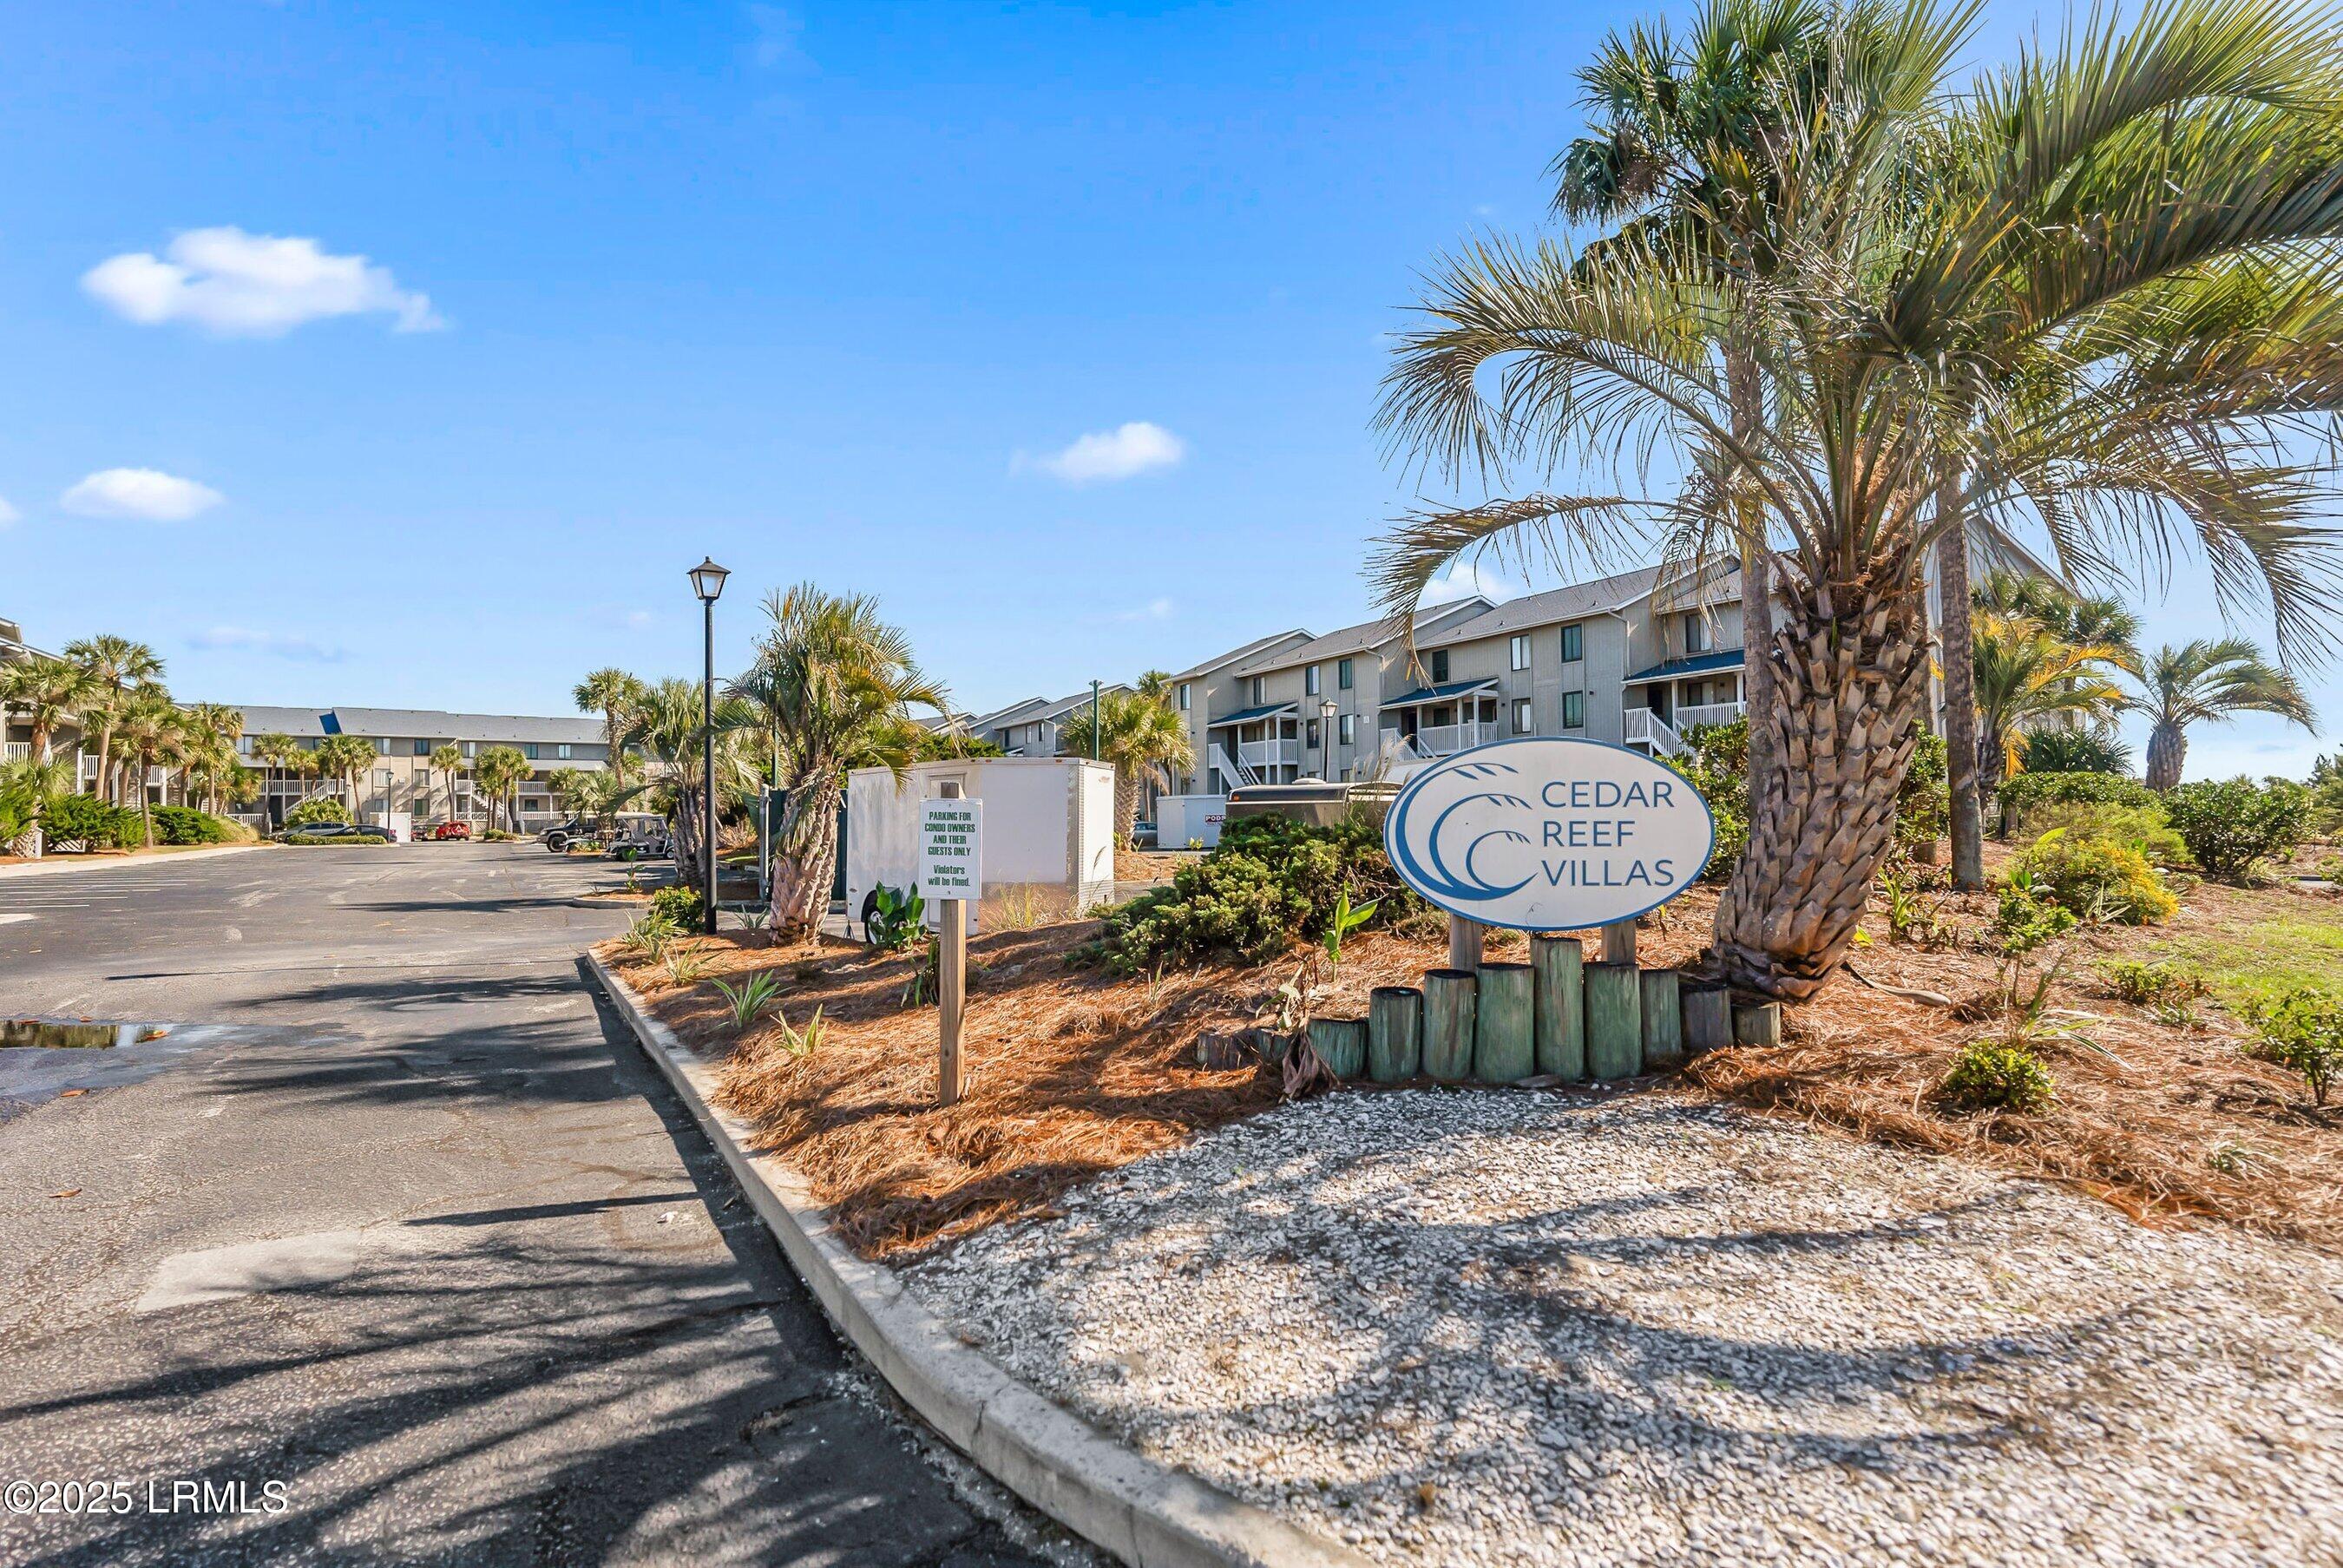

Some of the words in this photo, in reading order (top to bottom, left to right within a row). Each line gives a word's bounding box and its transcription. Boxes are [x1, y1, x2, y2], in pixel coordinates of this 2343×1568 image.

[1541, 781, 1675, 808] CEDAR
[929, 811, 958, 821] PARKING
[959, 812, 971, 821] FOR
[924, 823, 946, 832] CONDO
[947, 823, 975, 833] OWNERS
[1543, 820, 1635, 847] REEF
[933, 835, 947, 844] AND
[948, 836, 967, 844] THEIR
[928, 846, 952, 856] GUESTS
[954, 847, 971, 856] ONLY
[933, 864, 965, 875] Violators
[1540, 859, 1675, 887] VILLAS
[928, 876, 940, 886] will
[942, 877, 950, 886] be
[951, 876, 971, 887] fined.
